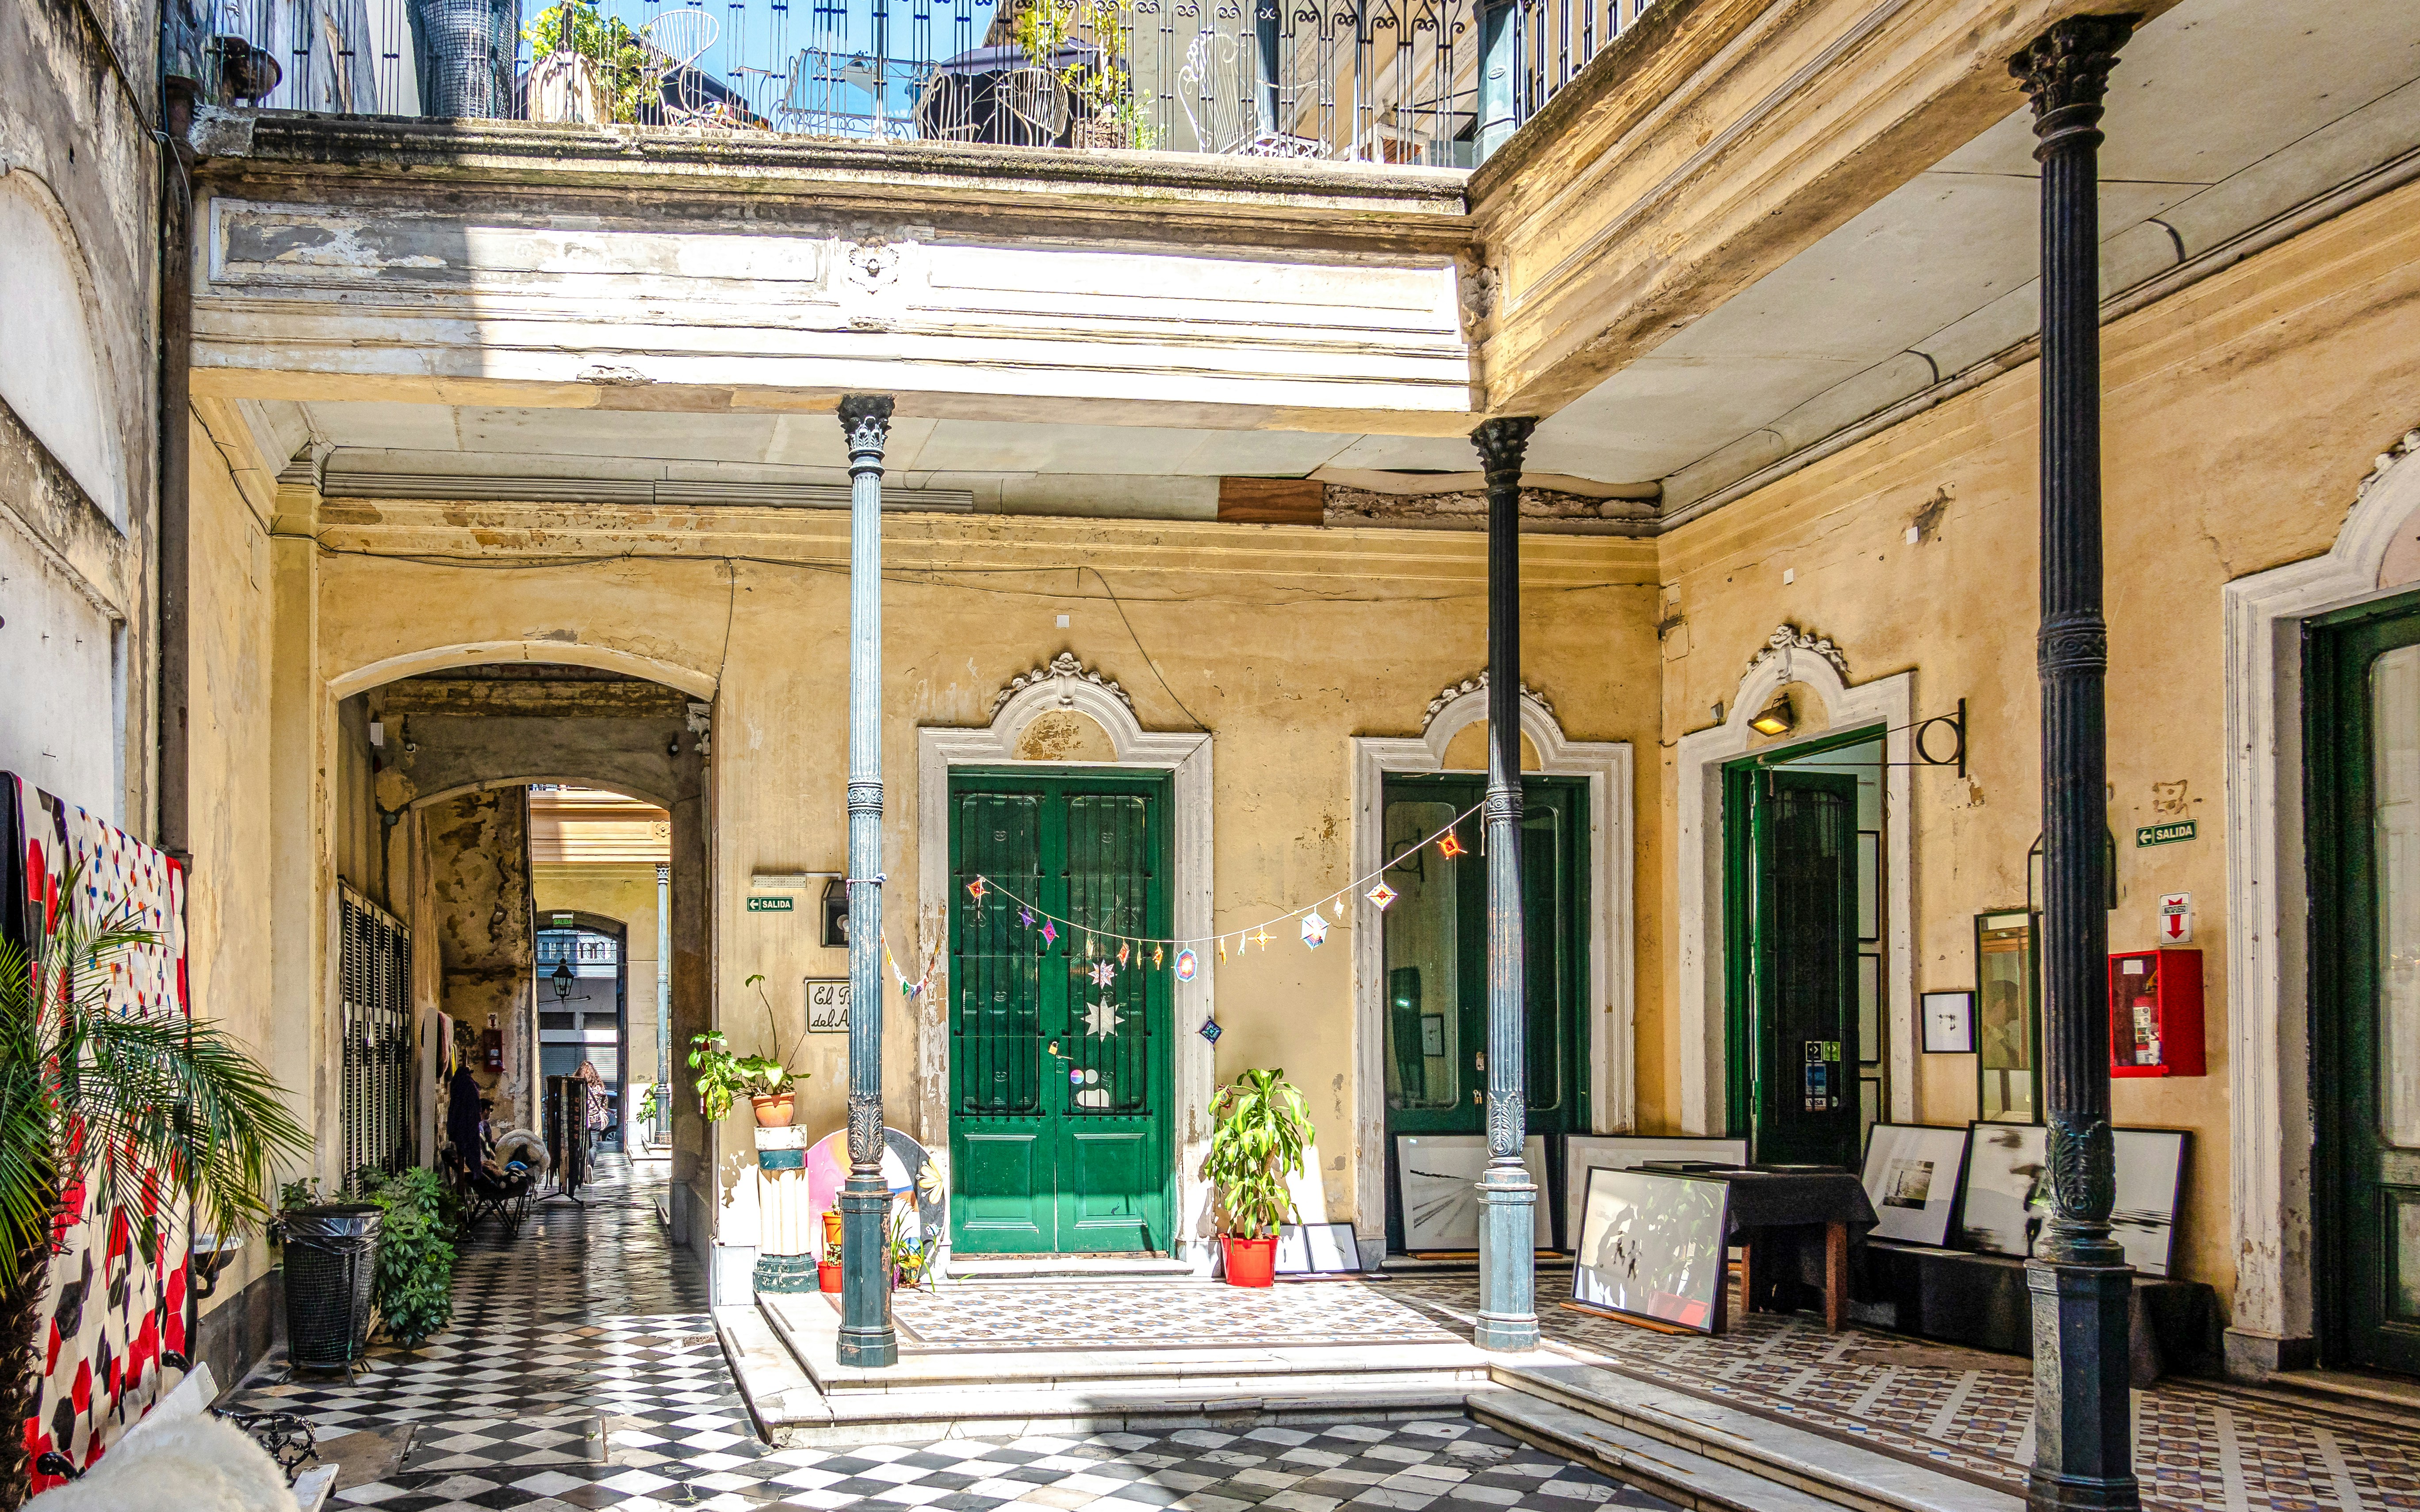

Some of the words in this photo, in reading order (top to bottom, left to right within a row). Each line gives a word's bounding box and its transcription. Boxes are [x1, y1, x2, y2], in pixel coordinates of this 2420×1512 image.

[2156, 825, 2193, 840] SALIDA
[814, 986, 834, 1005] El
[811, 1008, 835, 1027] del
